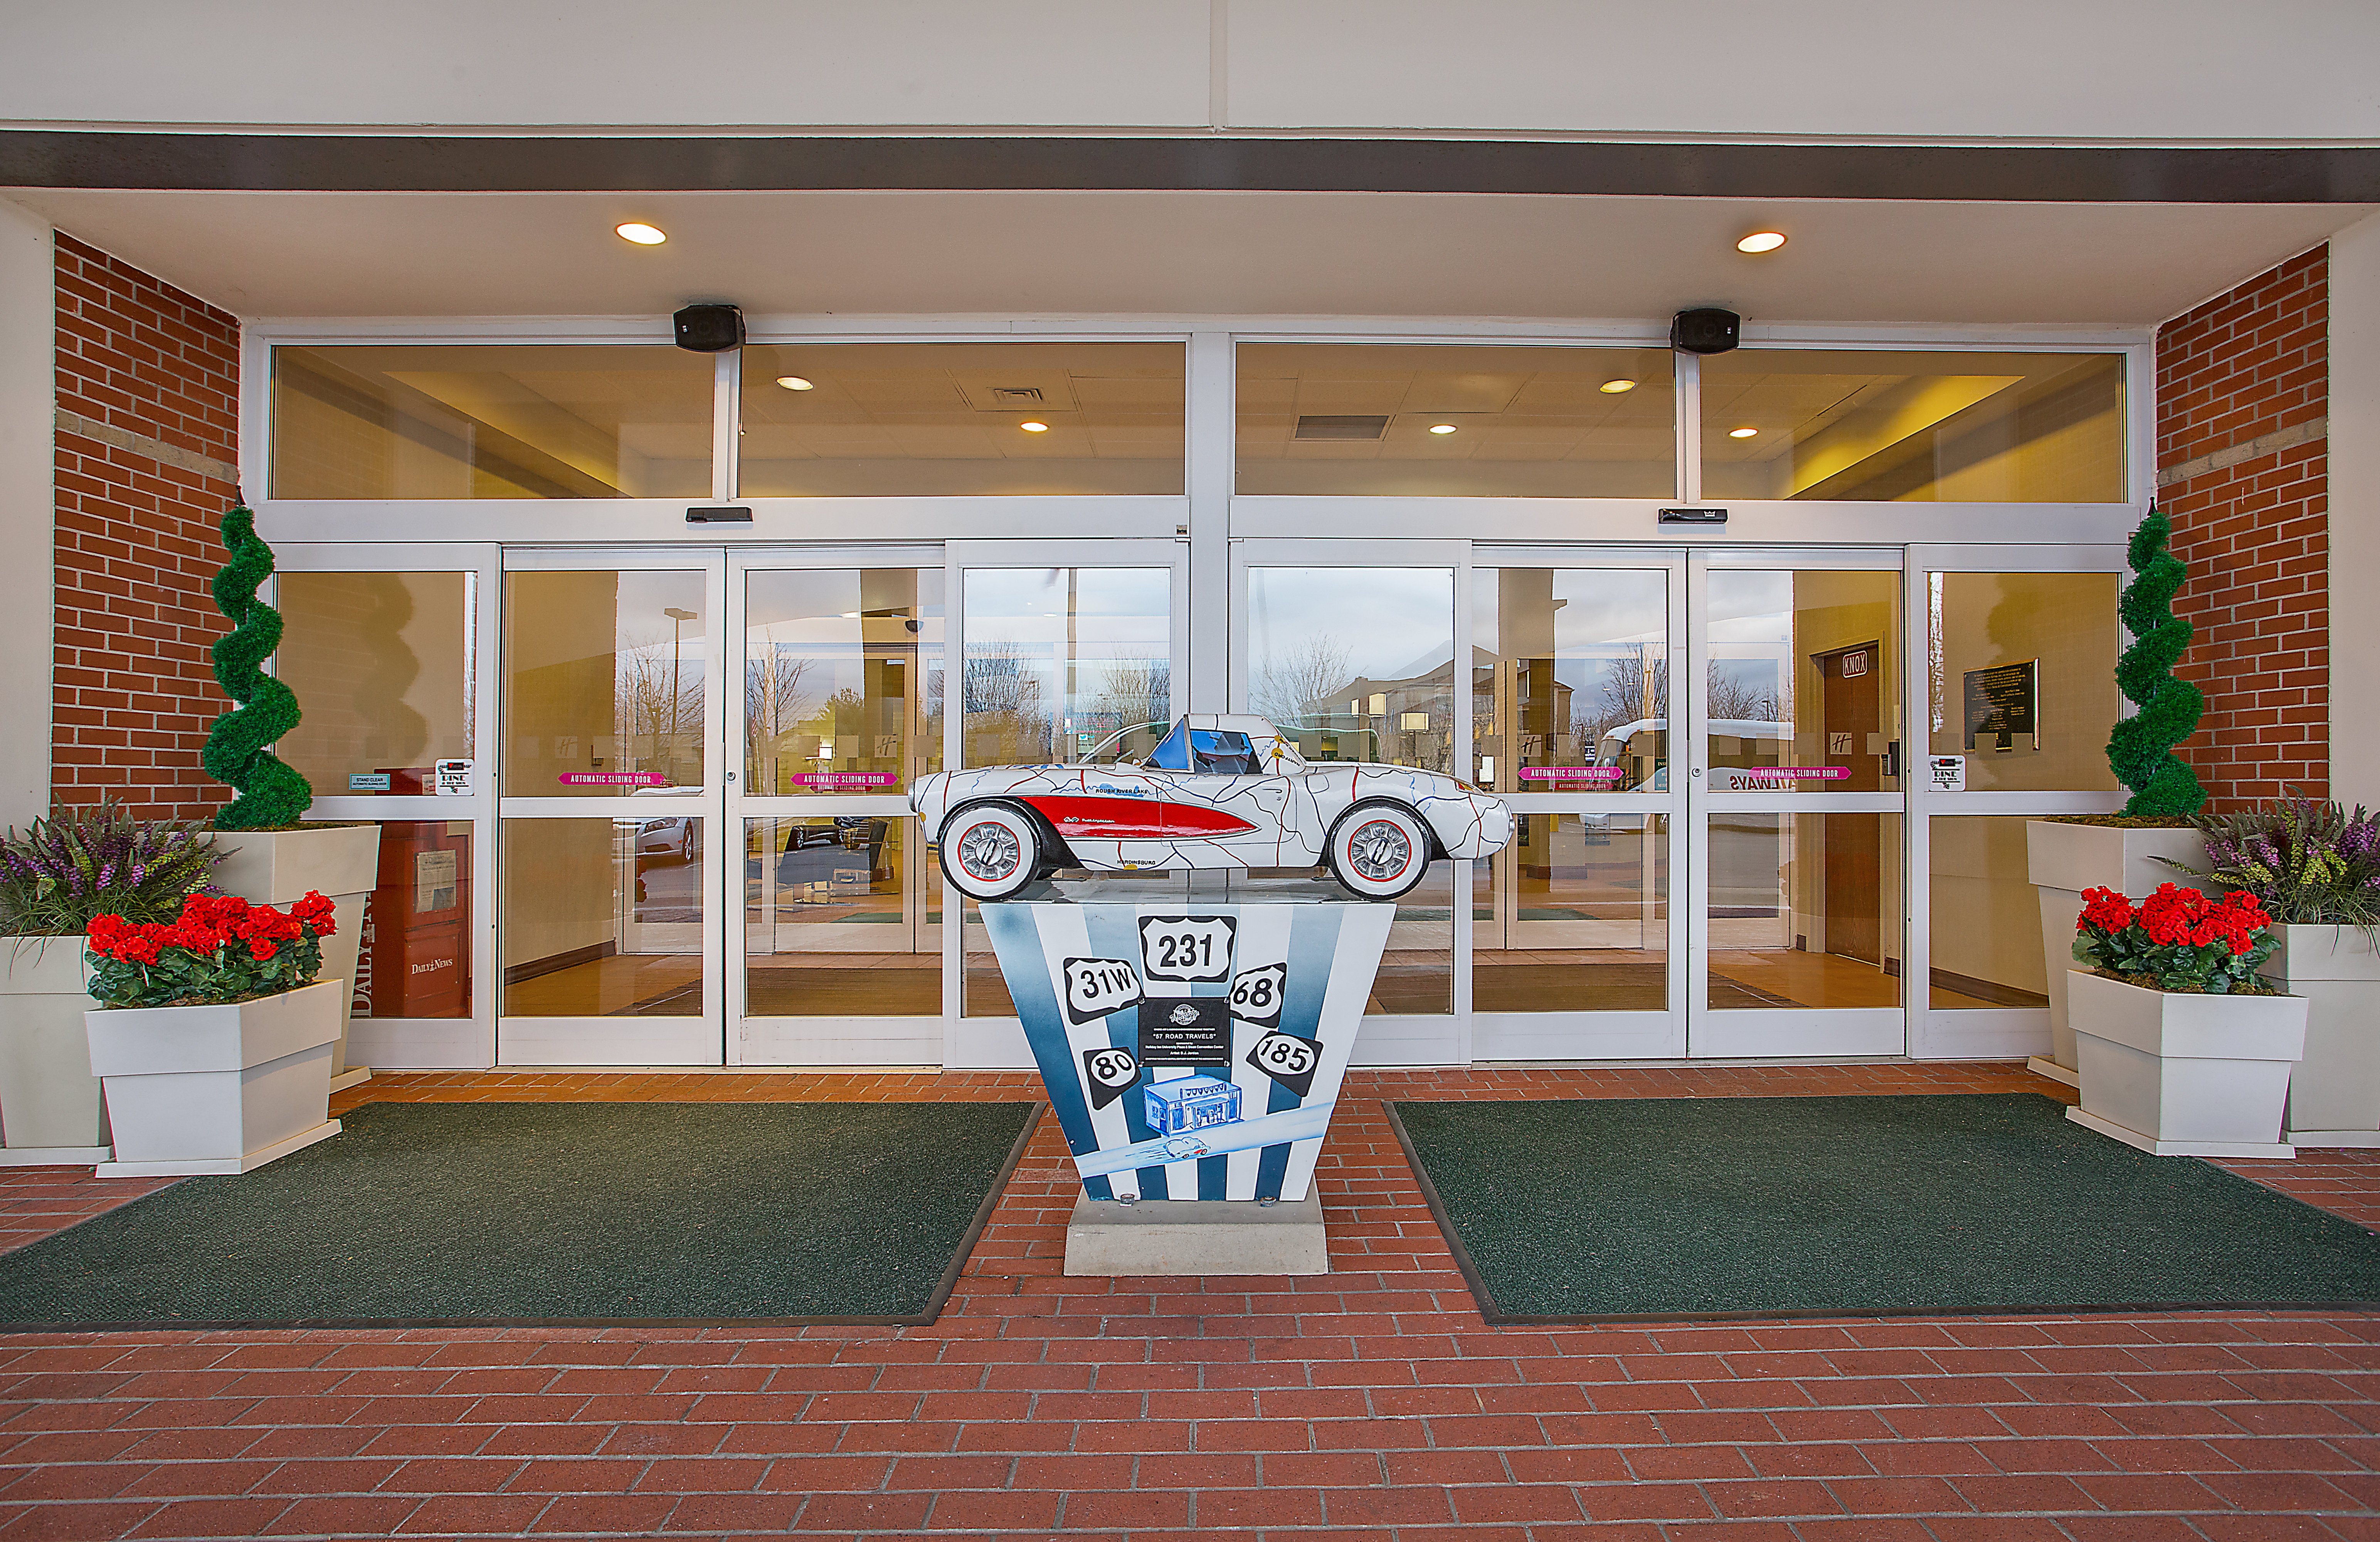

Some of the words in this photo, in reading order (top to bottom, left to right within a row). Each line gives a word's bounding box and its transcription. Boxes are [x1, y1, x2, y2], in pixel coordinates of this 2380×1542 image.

[1845, 654, 1865, 674] KNOX
[1274, 752, 1300, 766] HARTFORD
[1159, 934, 1212, 967] 231
[412, 963, 431, 975] DAILY
[434, 959, 452, 969] NEWS
[1081, 968, 1131, 998] 31W
[1233, 978, 1273, 1007] 68
[1095, 1054, 1132, 1080] 80
[1260, 1039, 1309, 1072] 185
[1186, 1083, 1223, 1094] WELCOME
